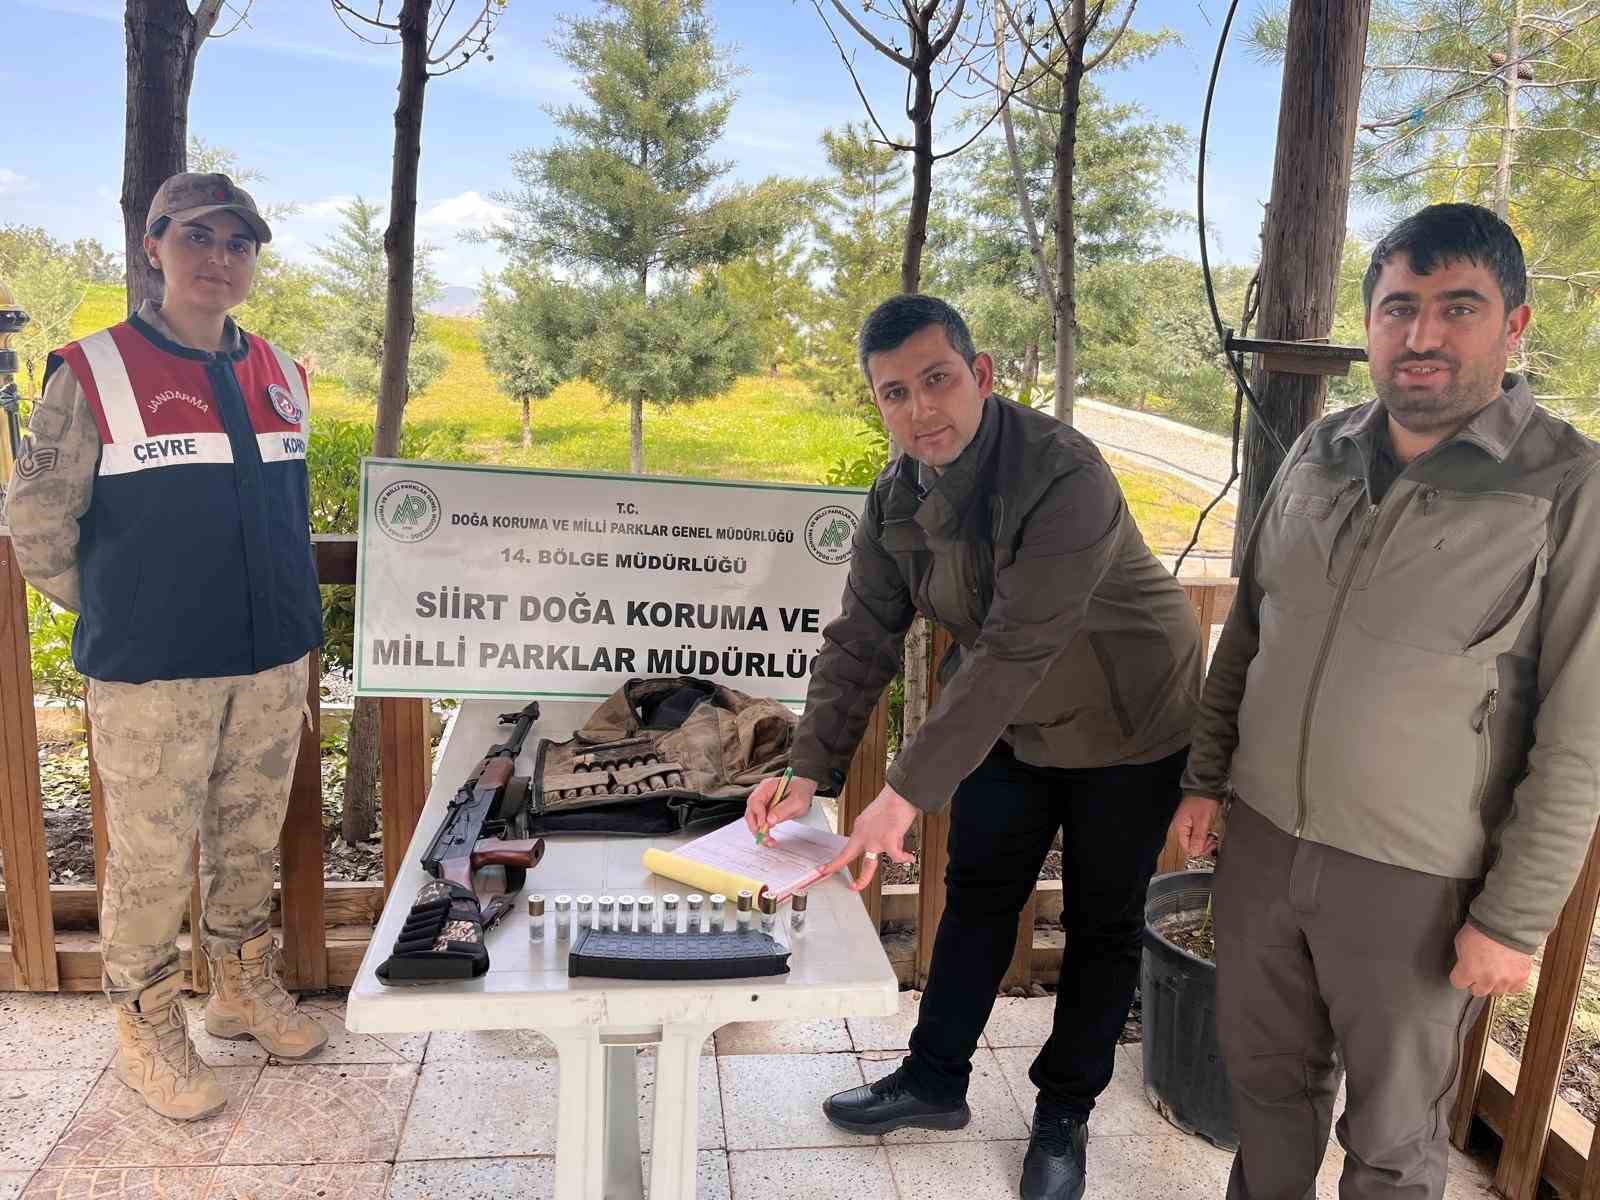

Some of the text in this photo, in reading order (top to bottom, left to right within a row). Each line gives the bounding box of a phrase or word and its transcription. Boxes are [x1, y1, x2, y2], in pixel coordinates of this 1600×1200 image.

[147, 390, 208, 413] JANDARMA
[133, 438, 198, 463] ÇEVRE
[616, 502, 639, 515] T.C.
[451, 512, 489, 527] DOĞA
[492, 516, 548, 530] KORUMA
[552, 519, 569, 531] VE
[572, 518, 606, 533] MİLLİ
[610, 522, 668, 537] PARKLAR
[671, 525, 712, 539] GENEL
[715, 527, 794, 543] MÜDÜRLÜĞÜ
[501, 548, 747, 574] 14. BÖLGE MÜDÜRLÜĞÜ
[416, 585, 820, 633] SİİRT DOĞA KORUMA VE
[372, 633, 466, 668] MİLLİ
[479, 642, 636, 673] PARKLAR
